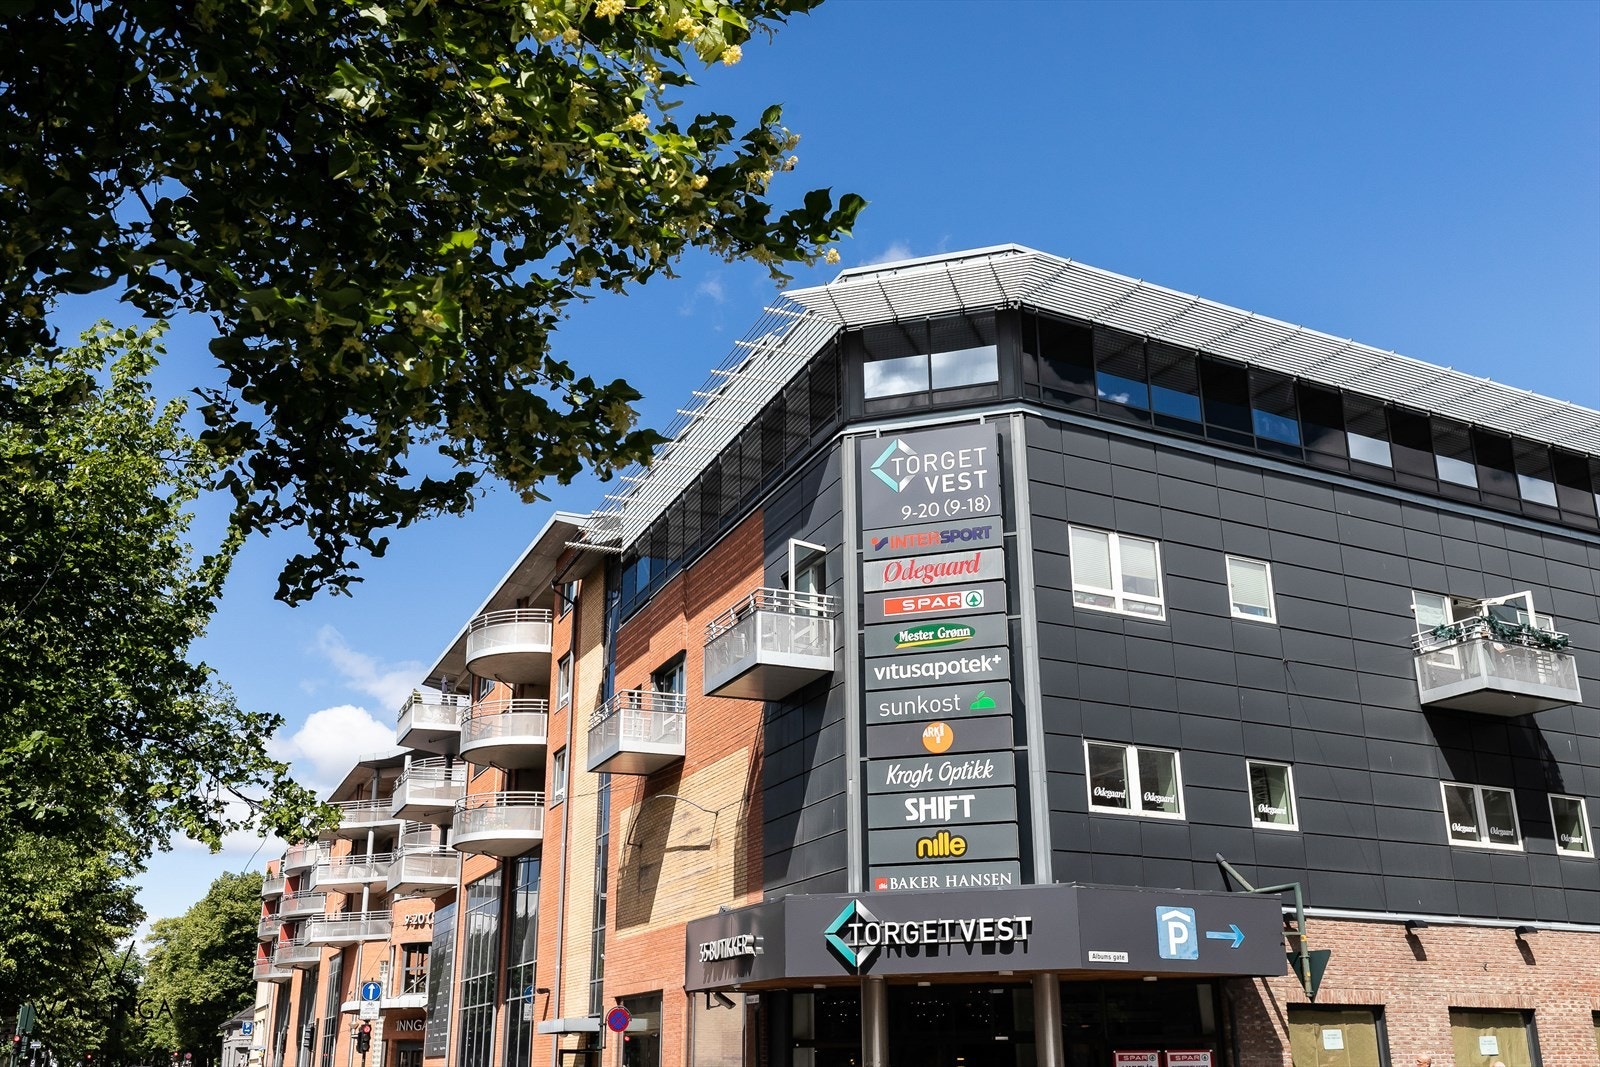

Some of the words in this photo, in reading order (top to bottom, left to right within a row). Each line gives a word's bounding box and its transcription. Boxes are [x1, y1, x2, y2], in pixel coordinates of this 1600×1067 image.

[891, 446, 987, 476] TORGET
[924, 470, 988, 494] VEST
[901, 502, 940, 520] 9-20
[944, 494, 991, 517] (9-18)
[890, 525, 992, 549] INTERSPORT
[883, 552, 982, 584] Ødegaard
[902, 594, 961, 611] SPAR
[899, 629, 934, 642] Mester
[937, 626, 971, 639] Grønn
[879, 693, 961, 717] sunkost
[886, 762, 933, 788] Krogh
[938, 759, 994, 785] Optikk
[904, 794, 976, 823] SHIFT
[916, 830, 967, 859] nille
[890, 875, 940, 890] BAKER
[946, 872, 1012, 887] HANSEN
[1167, 921, 1189, 955] P
[1092, 952, 1111, 960] Albums
[1113, 954, 1125, 962] gate
